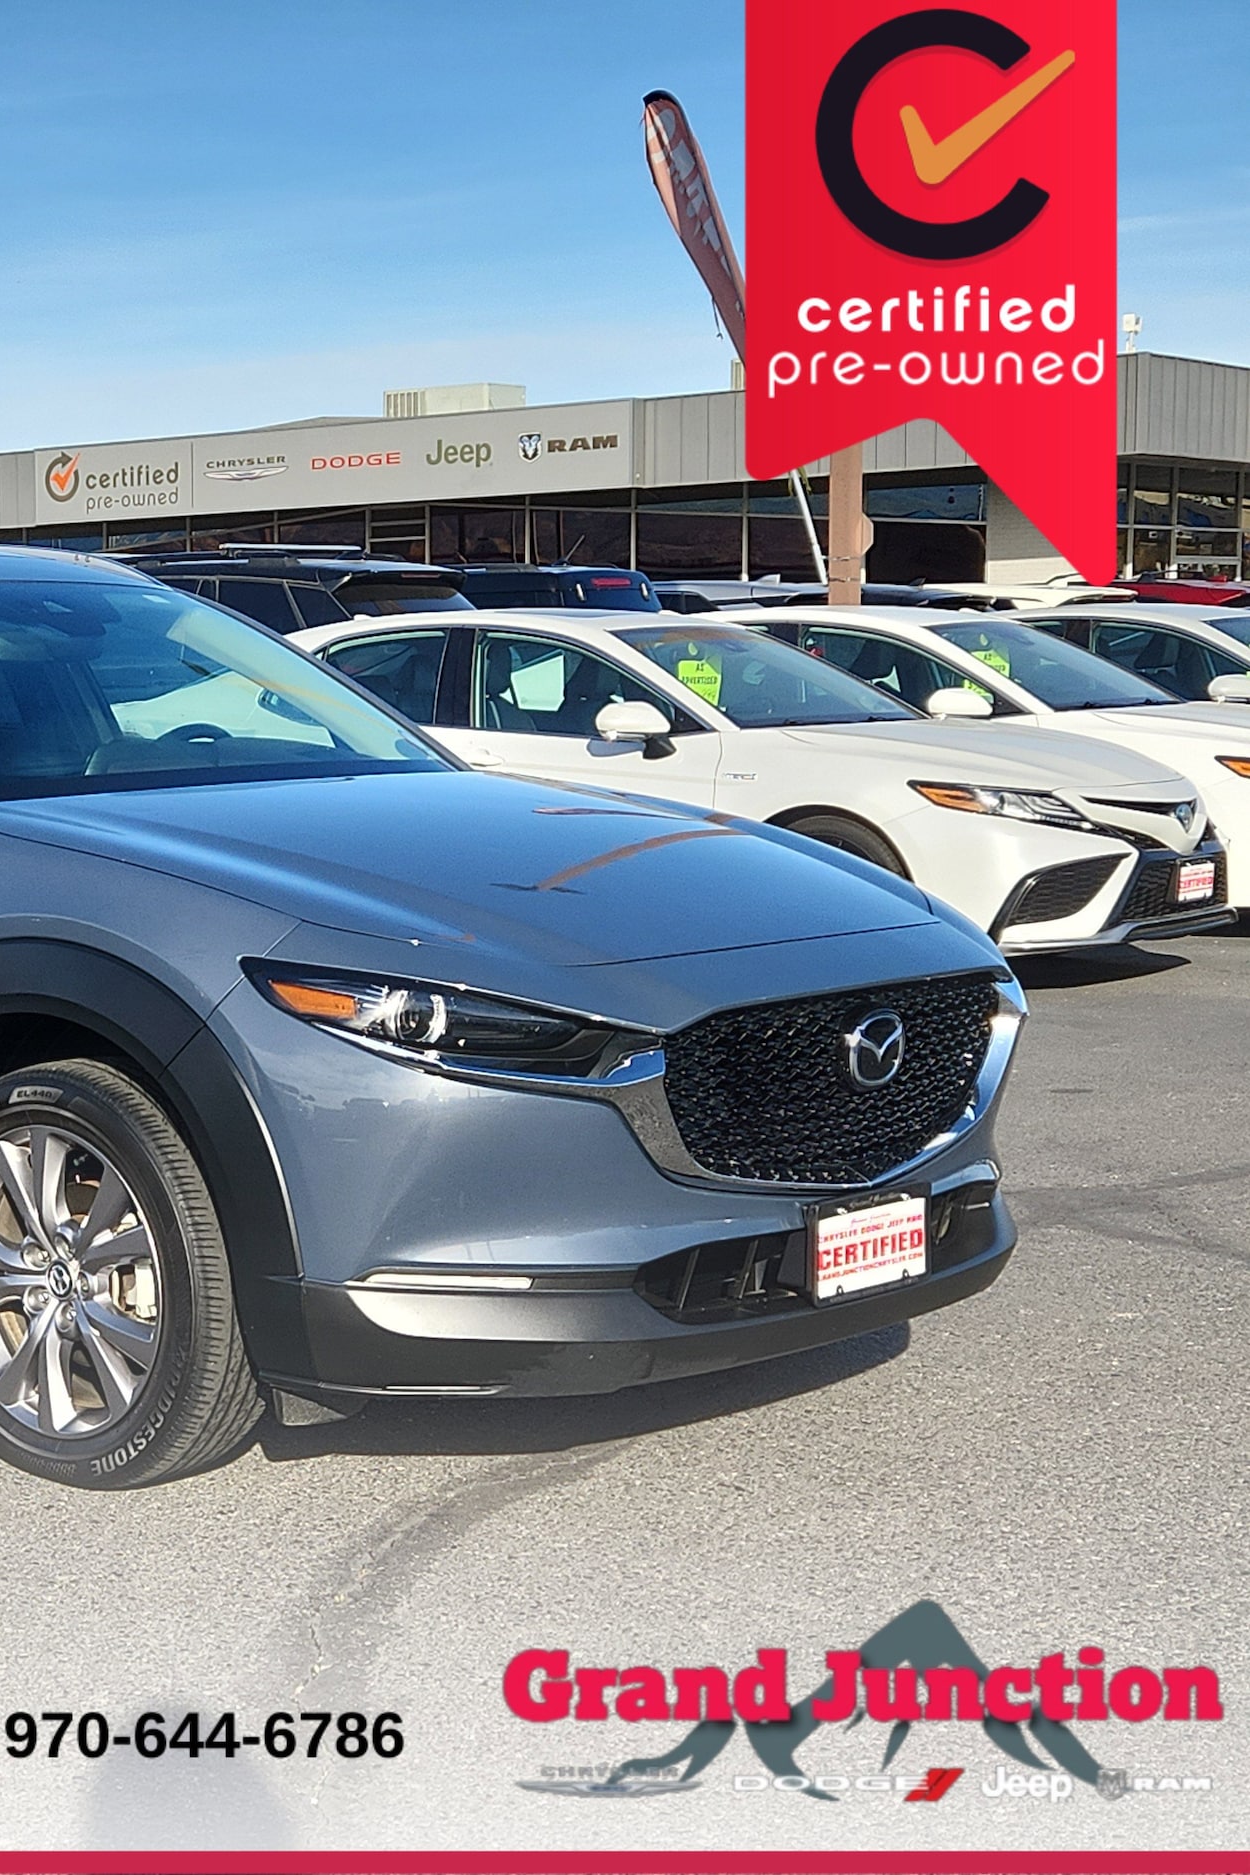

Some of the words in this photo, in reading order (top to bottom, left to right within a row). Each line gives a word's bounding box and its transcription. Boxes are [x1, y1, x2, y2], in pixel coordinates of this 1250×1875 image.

[426, 439, 492, 468] Jeep
[547, 433, 618, 454] RAM
[206, 455, 286, 470] CHRYSLER
[311, 451, 400, 470] DODGE
[85, 462, 179, 490] certified
[85, 486, 179, 513] pre-owned
[817, 1227, 924, 1272] CERTIFIED
